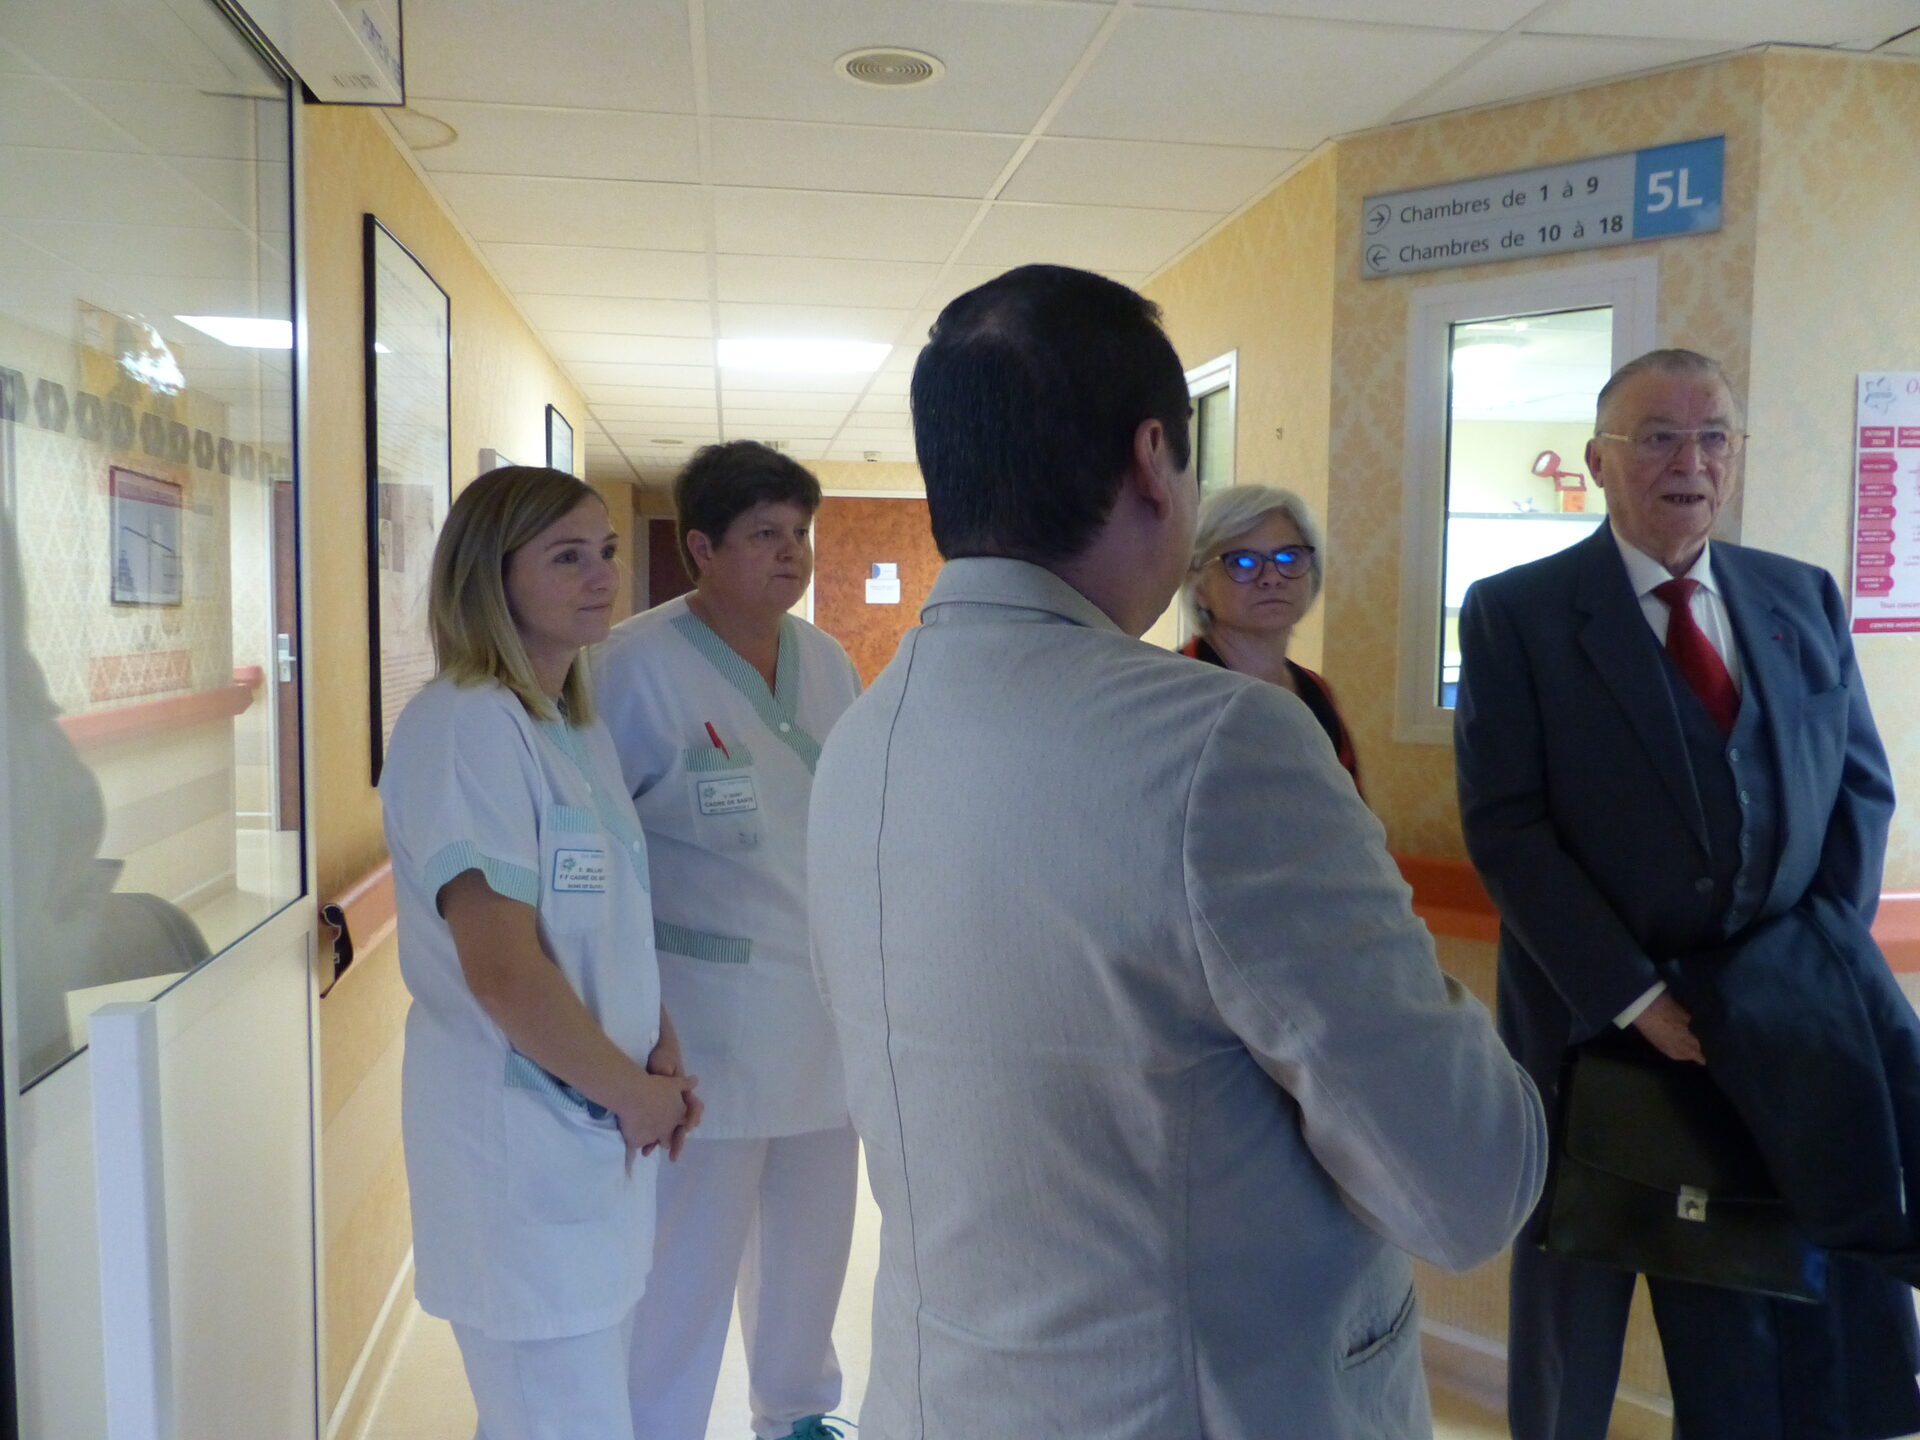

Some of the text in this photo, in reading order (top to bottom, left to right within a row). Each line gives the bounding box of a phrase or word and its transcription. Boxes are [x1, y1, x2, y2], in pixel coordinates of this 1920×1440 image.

[1400, 176, 1599, 223] Chambres de 1 à 9
[1647, 168, 1703, 213] 5L
[1399, 215, 1623, 263] Chambres de 10 à 18
